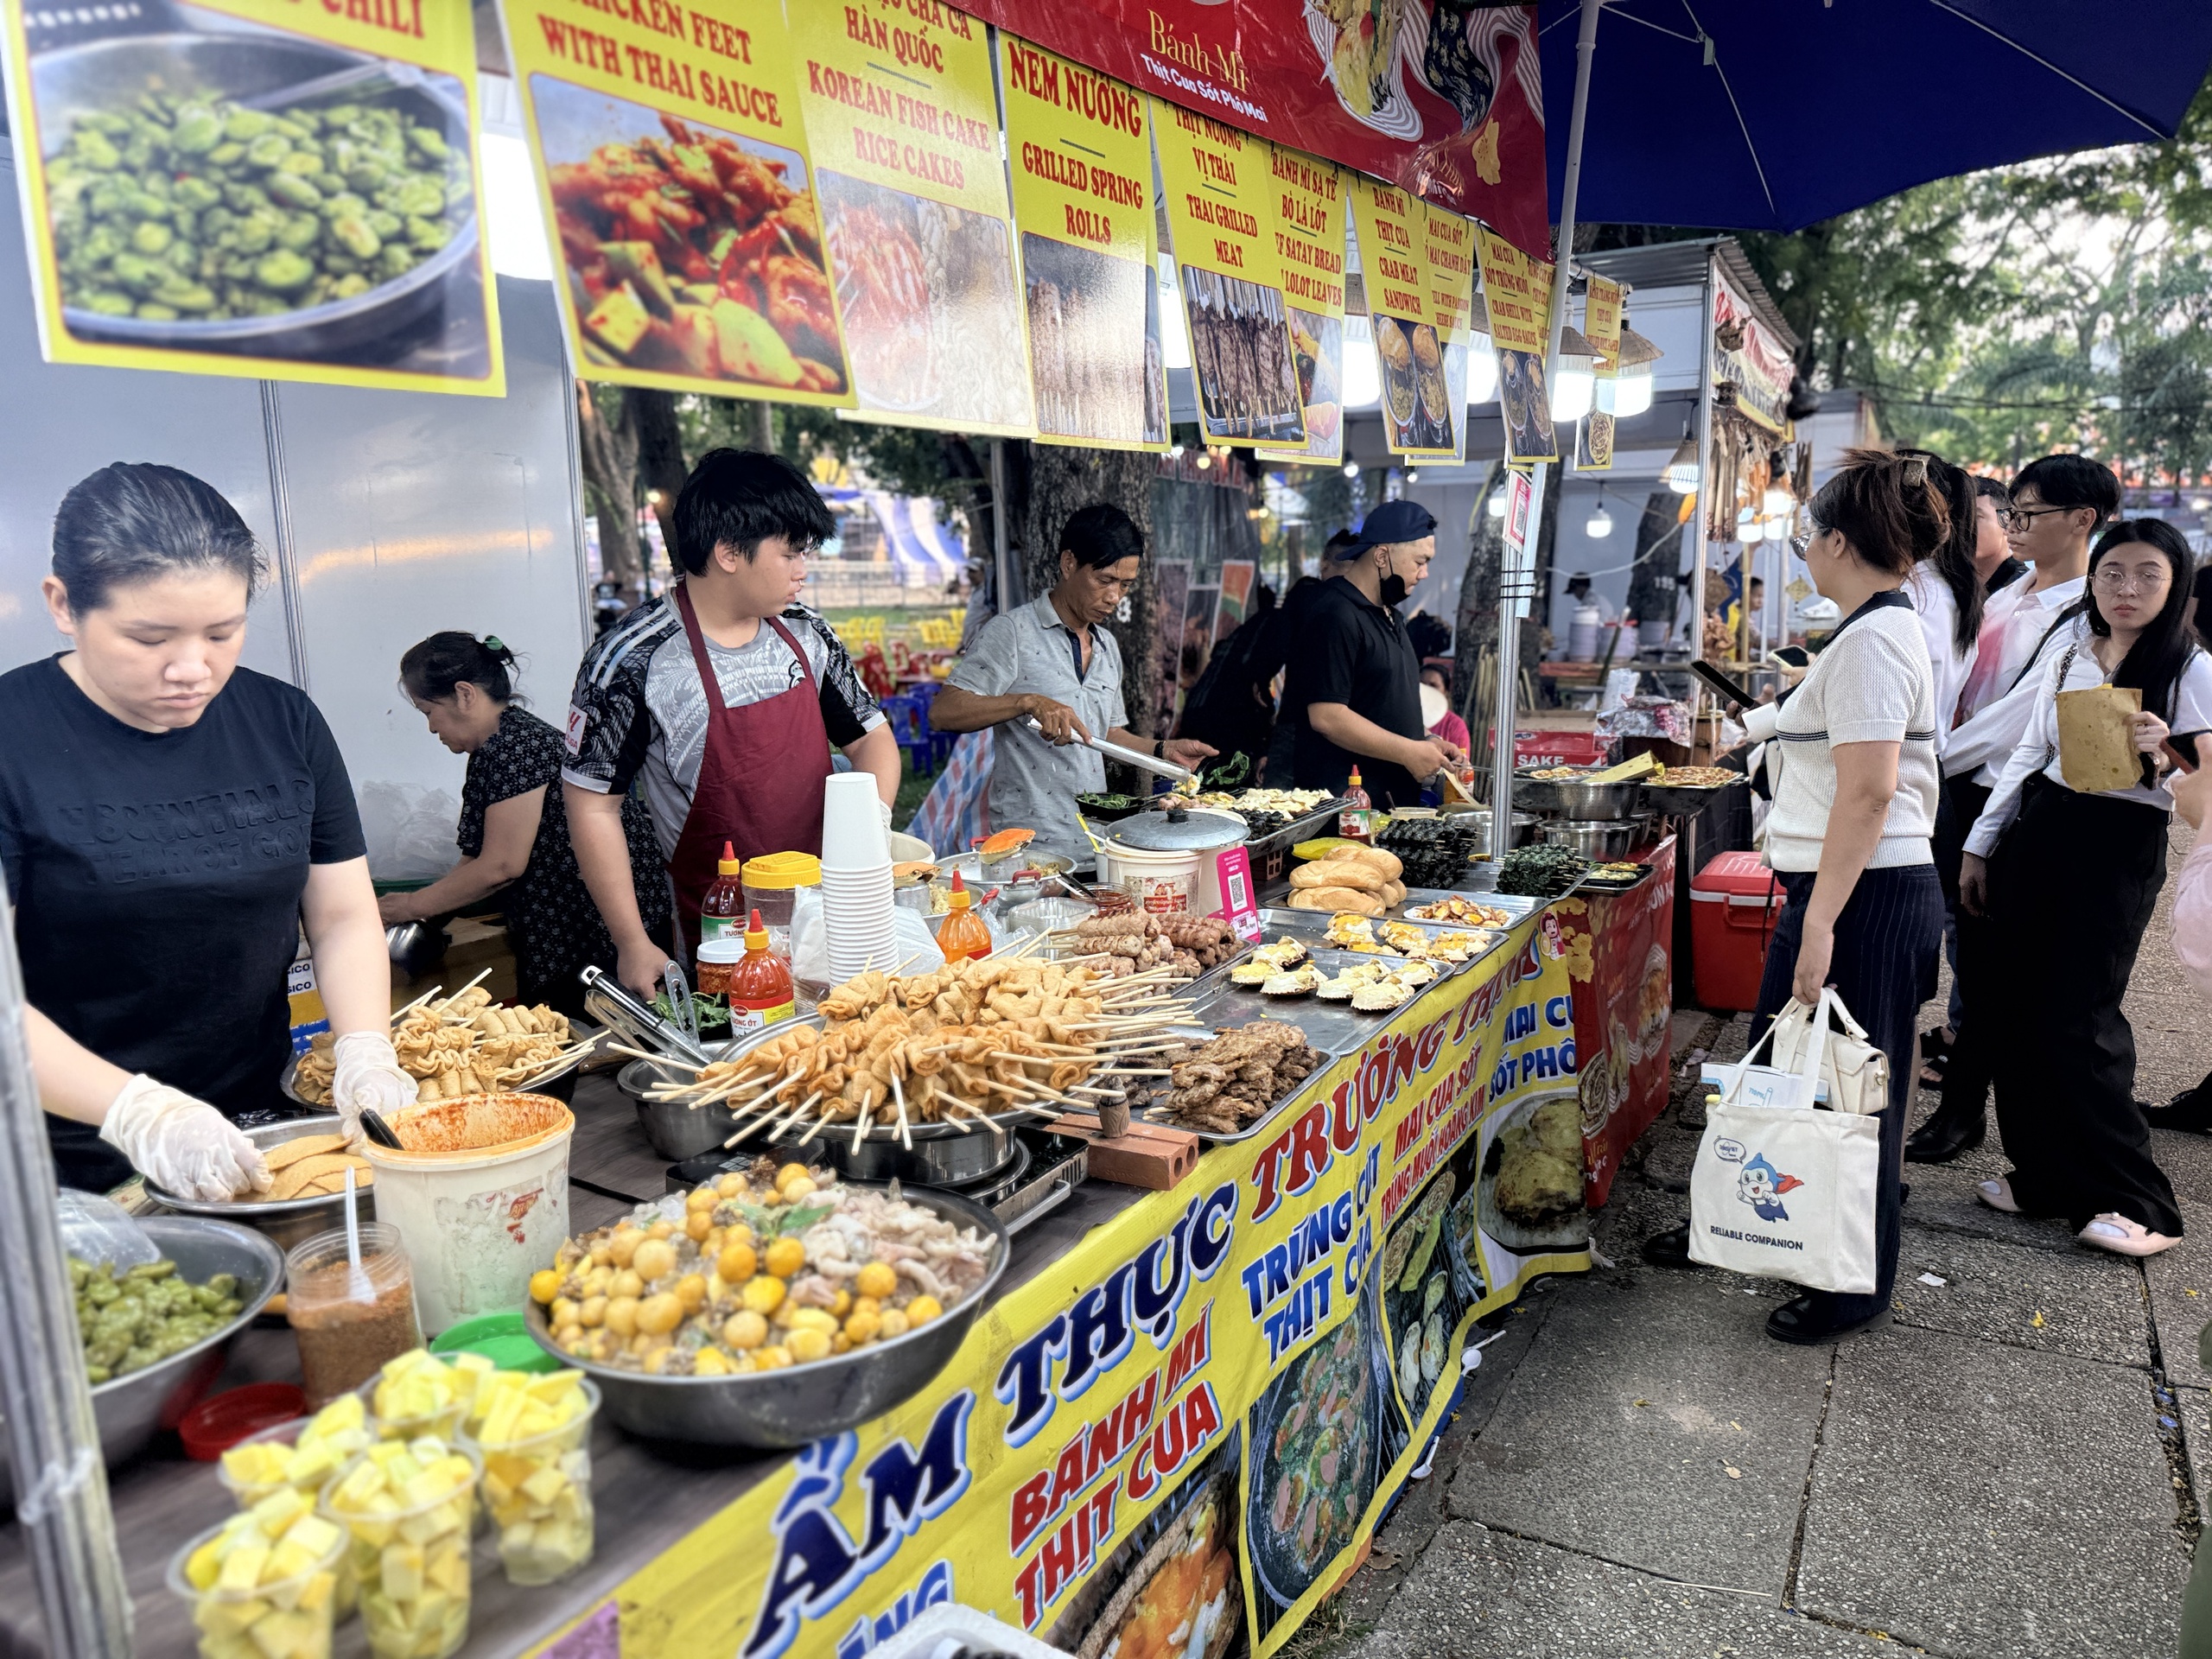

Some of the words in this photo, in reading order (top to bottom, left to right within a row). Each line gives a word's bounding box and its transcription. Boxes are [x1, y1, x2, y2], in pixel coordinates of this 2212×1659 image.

[689, 10, 752, 65] FEET
[844, 4, 889, 52] HÀN
[893, 25, 944, 73] QUỐC
[1147, 9, 1212, 77] Bánh
[537, 13, 623, 77] WITH
[626, 46, 696, 101] THAI
[699, 70, 782, 128] SAUCE
[1007, 41, 1060, 106] NEM
[1141, 54, 1172, 85] Thịt
[1171, 68, 1198, 94] Cua
[1197, 80, 1222, 104] Sốt
[1220, 89, 1244, 114] Phô
[1243, 99, 1268, 123] Mai
[807, 60, 893, 120] KOREAN
[896, 92, 940, 137] FISH
[943, 111, 991, 152] CAKE
[853, 127, 900, 170] RICE
[904, 144, 964, 189] CAKES
[1022, 141, 1088, 192] GRILLED
[1090, 166, 1143, 210] SPRING
[1192, 147, 1208, 181] VỊ
[1272, 149, 1298, 186] BÁNH
[1300, 162, 1311, 191] MÌ
[1313, 171, 1324, 197] SA
[1065, 204, 1111, 245] ROLLS
[1186, 194, 1215, 224] THAI
[1216, 202, 1258, 238] GRILLED
[1282, 190, 1294, 220] BÒ
[1296, 196, 1307, 226] LÁ
[1310, 199, 1326, 233] LỐT
[1376, 218, 1395, 246] THỊT
[1395, 225, 1410, 249] CUA
[1429, 217, 1440, 238] MAI
[1440, 222, 1451, 243] CUA
[1214, 238, 1243, 268] MEAT
[1286, 236, 1313, 265] SATAY
[1314, 246, 1341, 275] BREAD
[1379, 256, 1399, 280] CRAB
[1399, 262, 1418, 286] MEAT
[1491, 242, 1503, 262] MAI
[1503, 246, 1515, 265] CUA
[1285, 270, 1310, 298] LOLOT
[1312, 279, 1342, 307] LEAVES
[1383, 288, 1422, 315] SANDWICH
[1492, 299, 1506, 316] CRAB
[1522, 1038, 1577, 1084] PHÔ
[1393, 1098, 1426, 1165] MAI
[1427, 1071, 1456, 1128] CUA
[1469, 1084, 1486, 1128] KIM
[995, 1179, 1239, 1447] THỰC
[1250, 1008, 1454, 1224] TRƯỜNG
[1263, 1262, 1333, 1365] THỊT
[1011, 1366, 1162, 1557] BÁNH
[1013, 1470, 1122, 1632] THỊT
[1127, 1379, 1224, 1502] CUA
